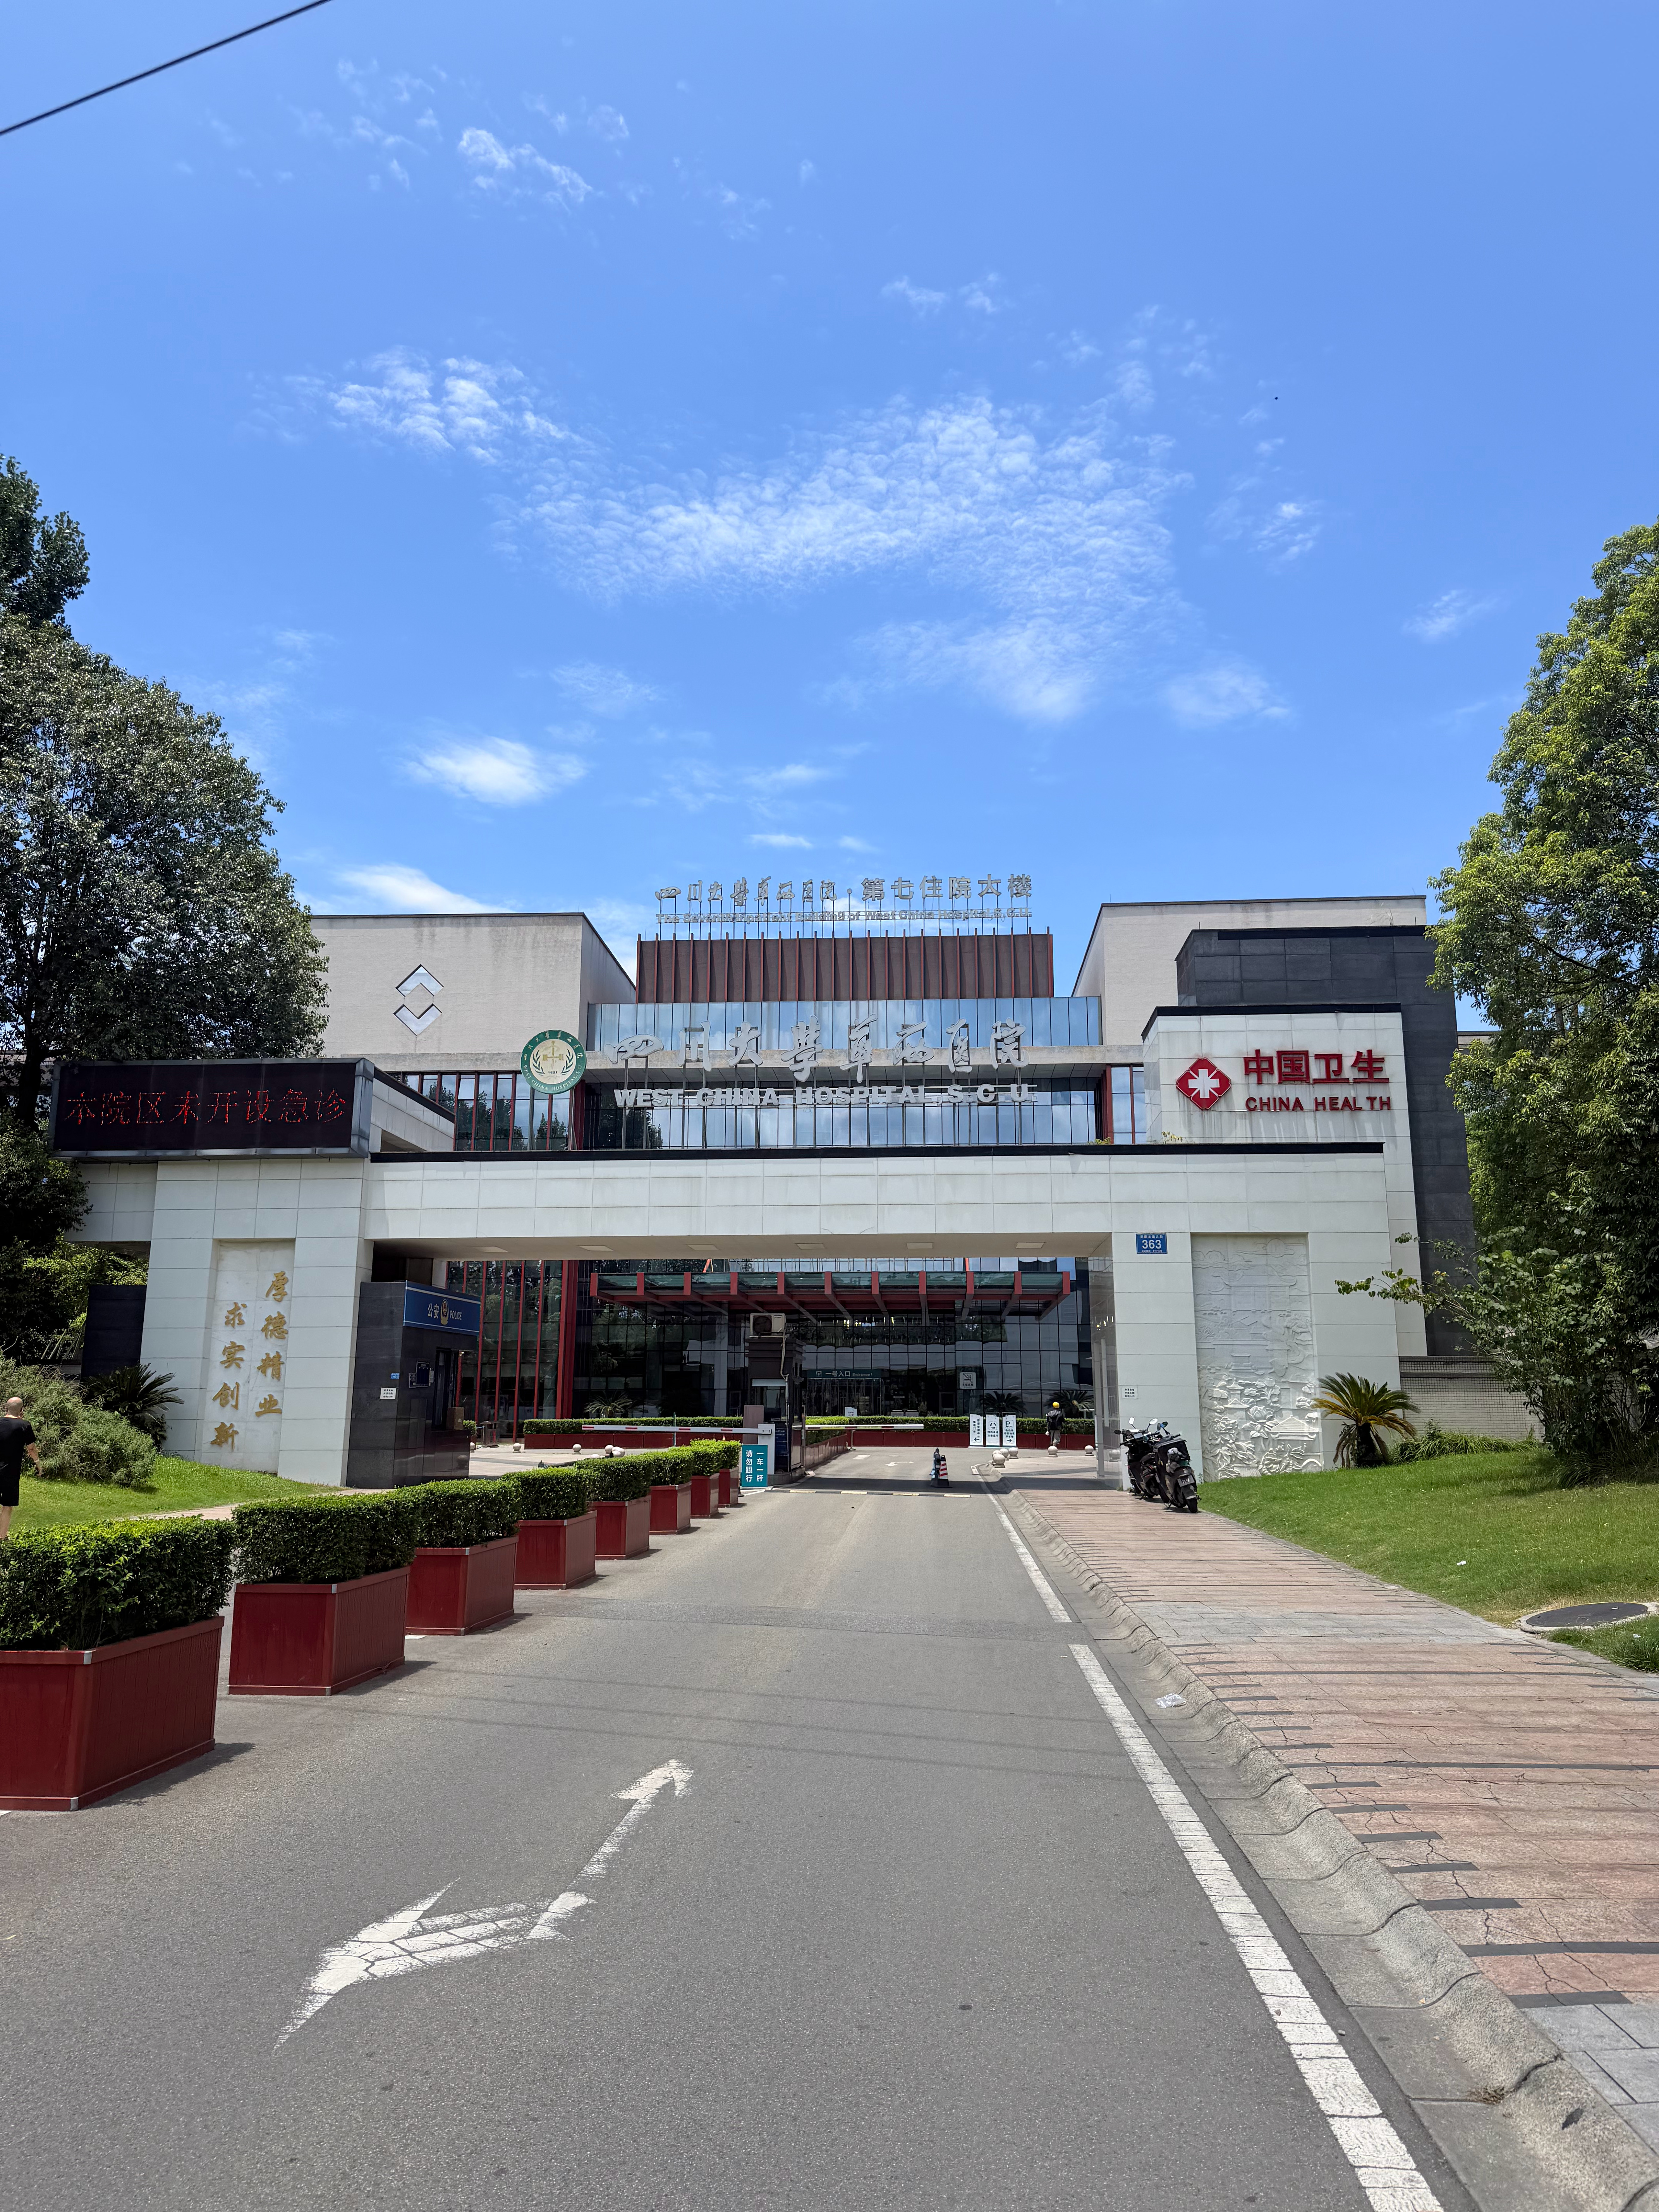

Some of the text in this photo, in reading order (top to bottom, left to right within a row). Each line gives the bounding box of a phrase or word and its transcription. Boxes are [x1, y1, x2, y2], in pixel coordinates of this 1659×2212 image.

[656, 914, 679, 923] The
[684, 913, 732, 922] Seventh
[736, 912, 792, 924] Inpatient
[795, 911, 845, 921] Building
[848, 911, 860, 920] of
[865, 911, 895, 920] West
[899, 910, 934, 919] China
[1243, 1049, 1389, 1084] 中国卫生
[613, 1088, 684, 1107] WEST
[697, 1087, 779, 1106] CHINA
[1245, 1097, 1304, 1111] CHINA
[64, 1088, 347, 1125] 本院区未开设急诊
[1142, 1240, 1162, 1249] 363
[428, 1303, 439, 1319] 公安
[450, 1310, 462, 1320] POLICE
